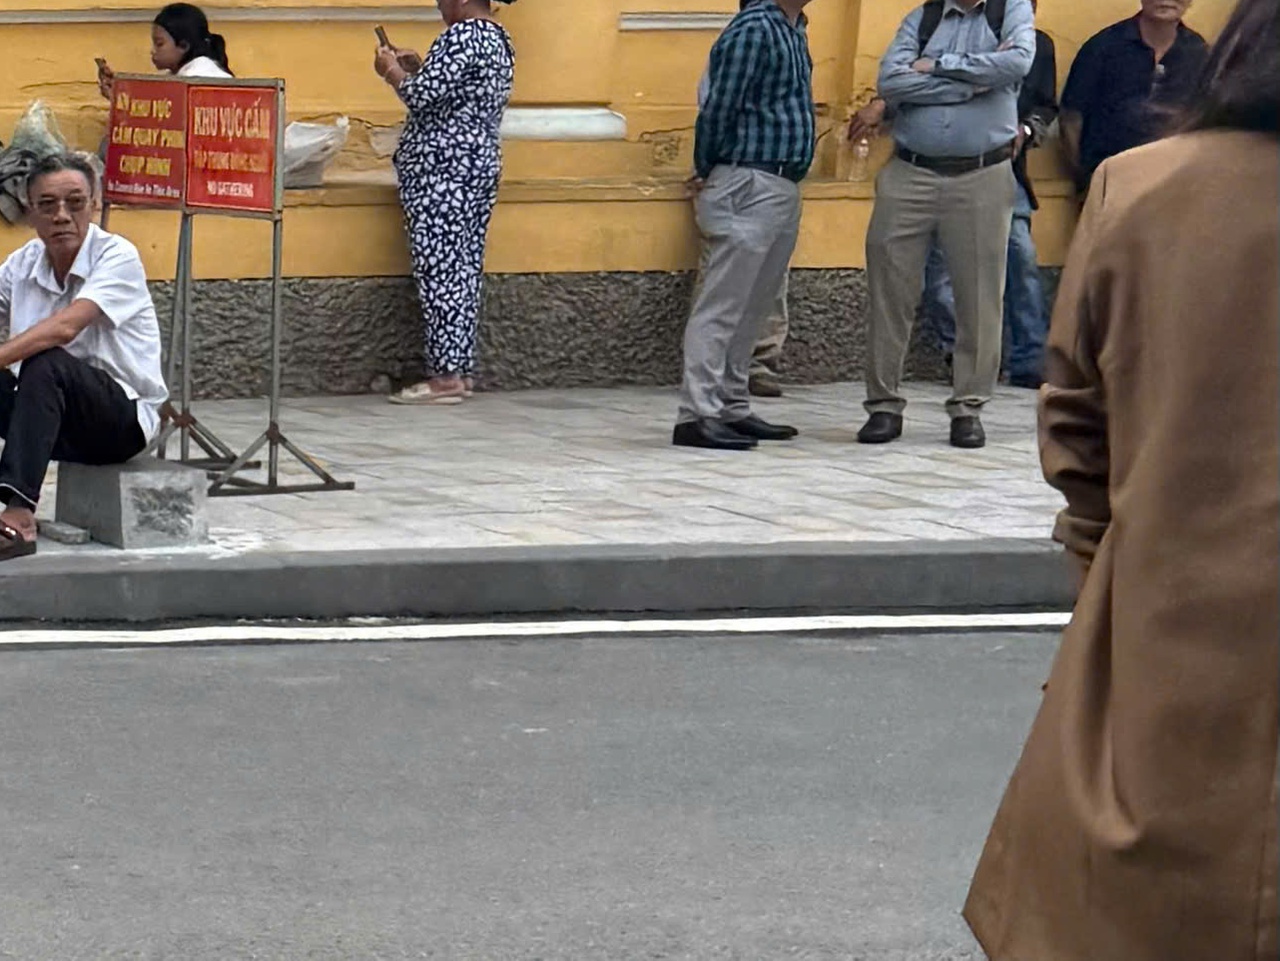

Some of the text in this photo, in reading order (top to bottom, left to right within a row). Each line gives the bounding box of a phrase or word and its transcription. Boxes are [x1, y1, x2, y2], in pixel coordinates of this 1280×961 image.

[194, 96, 271, 142] KHU VỰC CẤM
